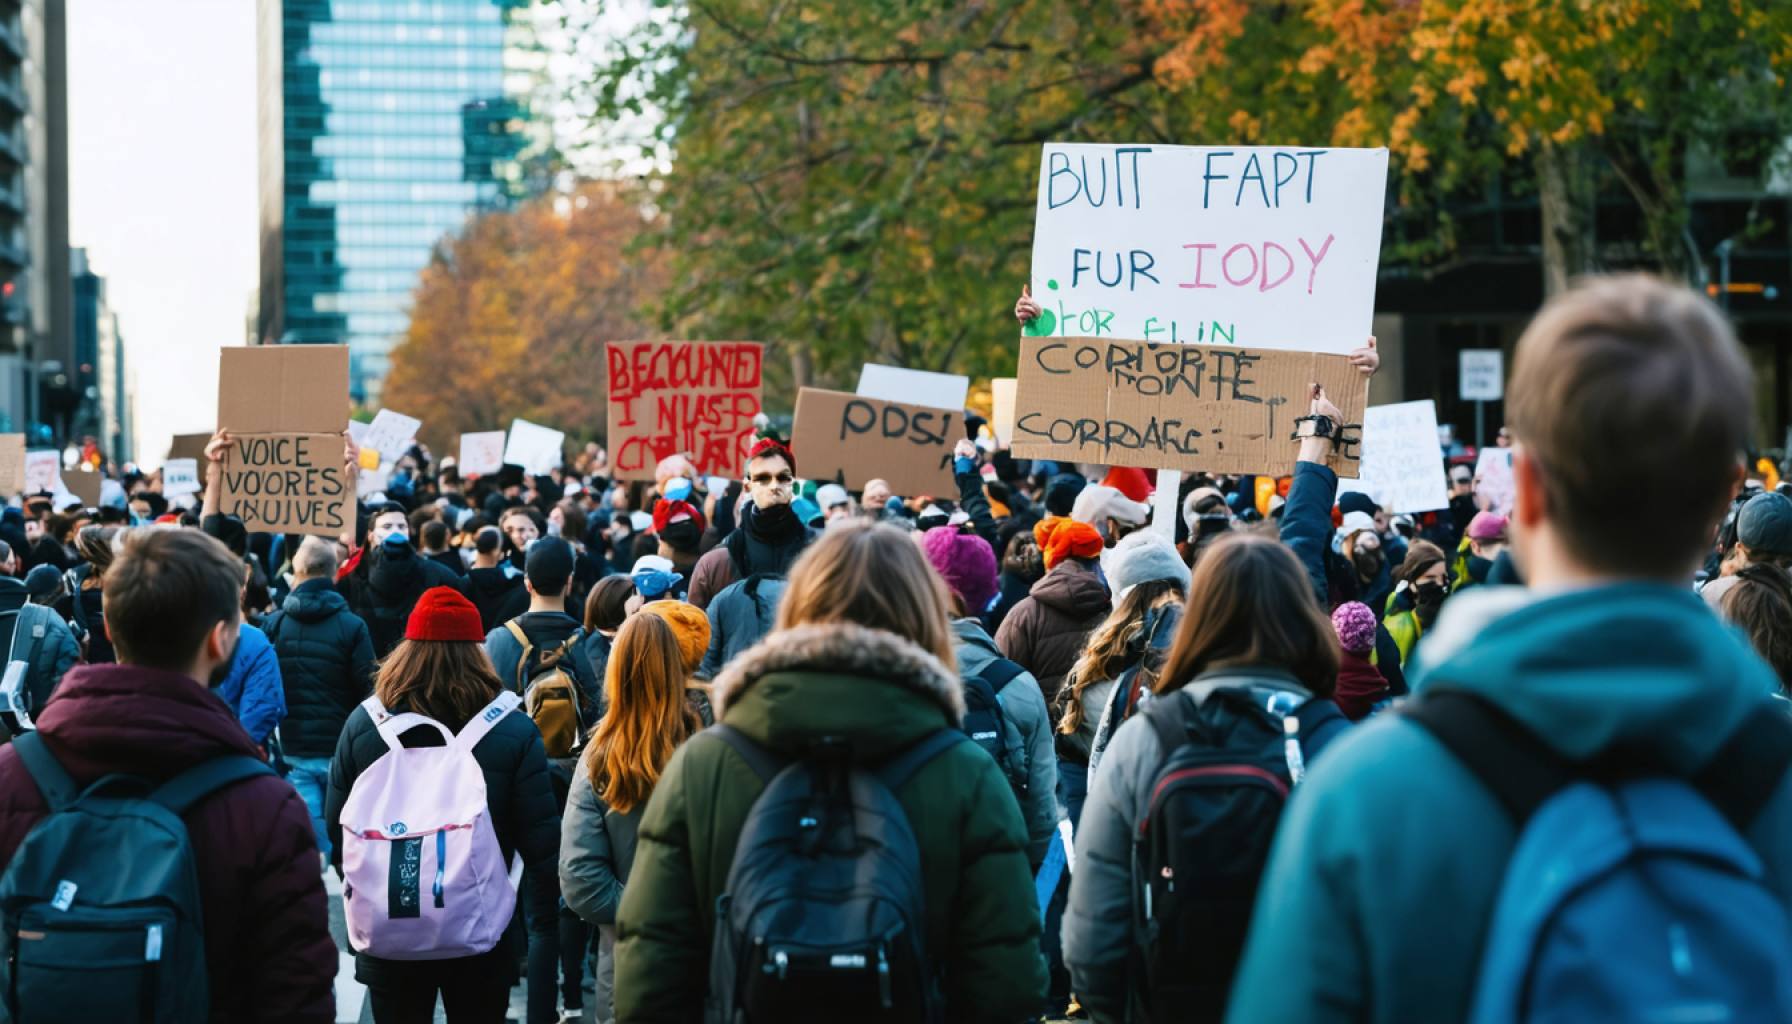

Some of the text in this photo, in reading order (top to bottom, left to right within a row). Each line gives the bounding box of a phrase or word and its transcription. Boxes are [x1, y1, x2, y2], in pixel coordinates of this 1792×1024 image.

[1203, 151, 1327, 208] FAPT
[1072, 248, 1160, 291] FUR
[239, 437, 312, 467] VOICE
